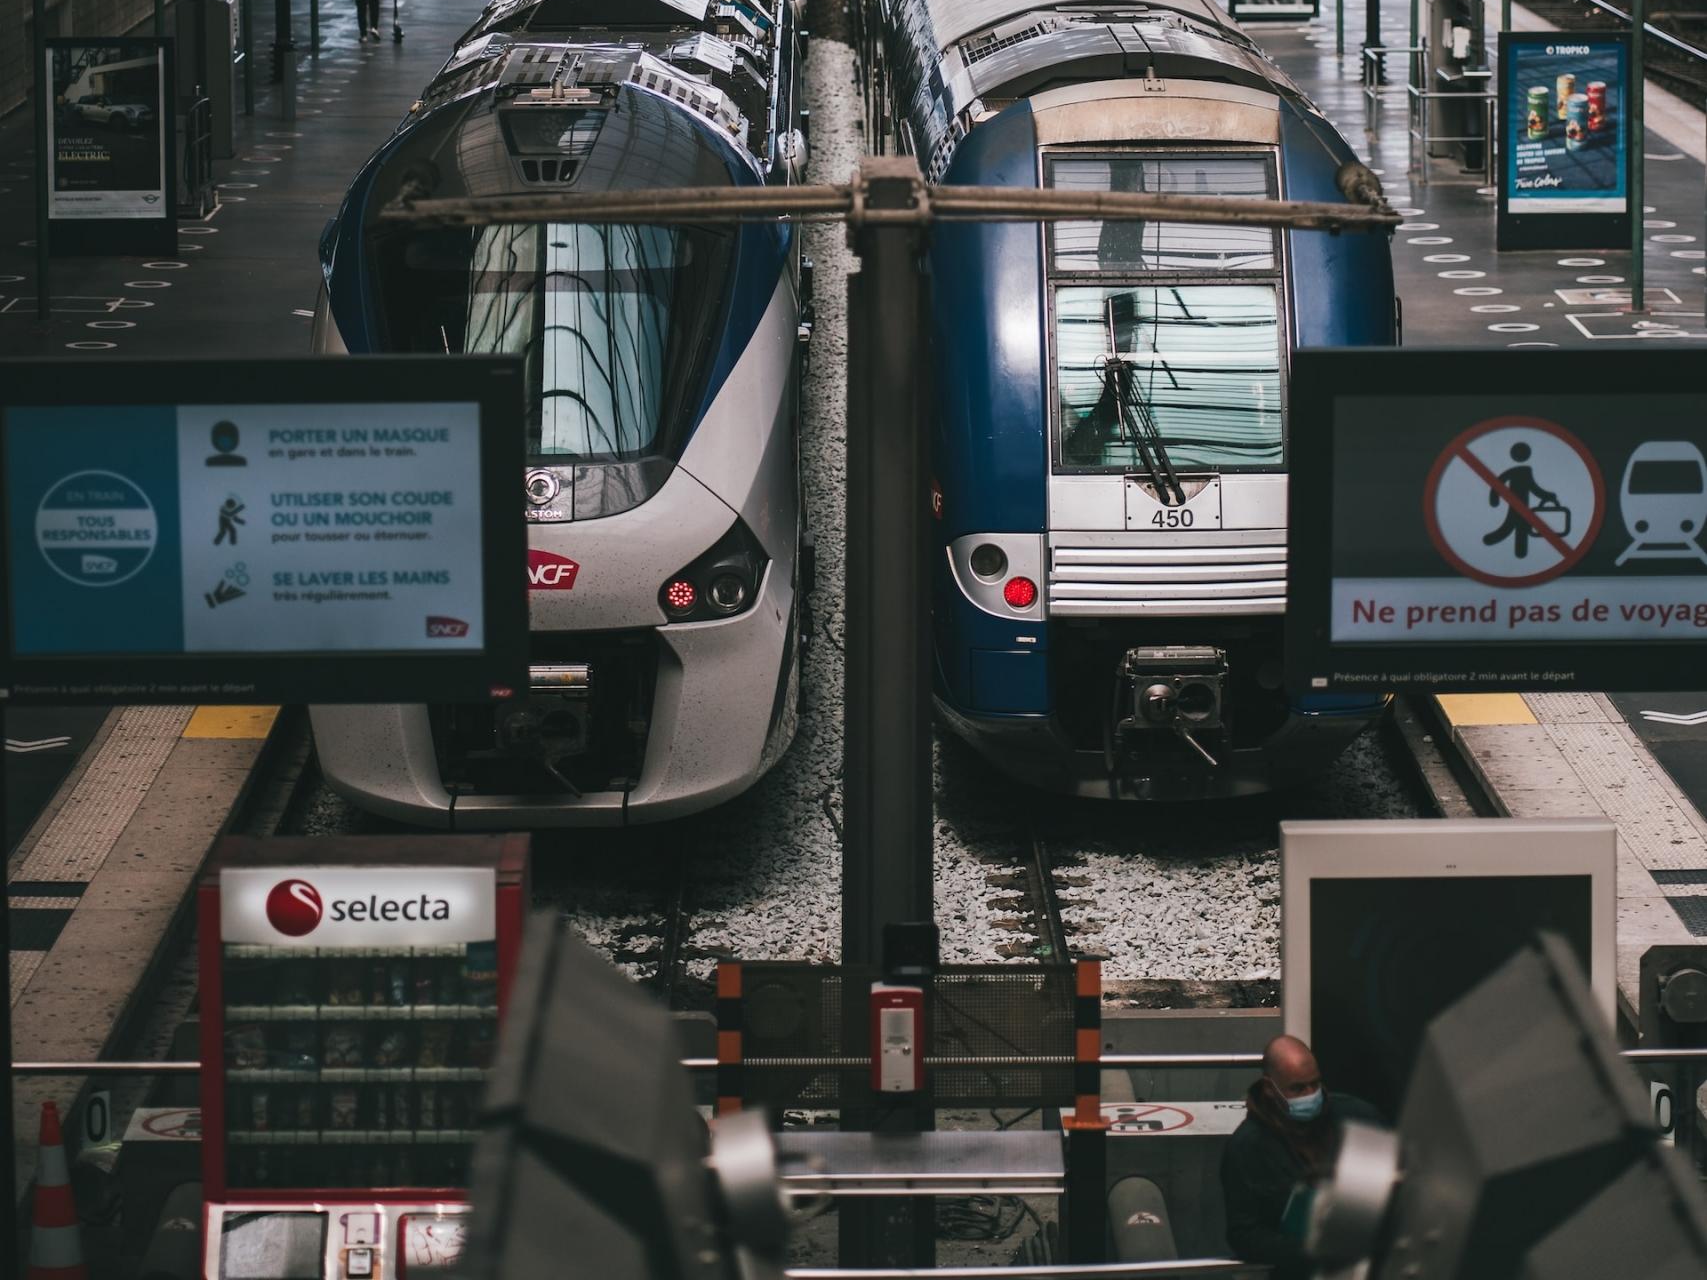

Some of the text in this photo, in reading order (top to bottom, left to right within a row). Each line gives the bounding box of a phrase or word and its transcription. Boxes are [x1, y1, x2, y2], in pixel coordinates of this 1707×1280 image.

[1555, 46, 1590, 55] TROPICO
[269, 428, 449, 443] PORTER UN MASQUE
[268, 446, 417, 460] en gare et dans le train.
[271, 491, 453, 507] UTILISER SON COUDE
[77, 516, 115, 527] TOUS
[271, 511, 433, 526] OU UN MOUCHOIR
[1152, 509, 1193, 528] 450
[42, 529, 151, 541] RESPONSABLES
[271, 530, 432, 544] pour tousser ou éternuer.
[273, 570, 450, 586] SE LAVER LES MAINS
[273, 590, 392, 603] très régulièrement.
[1353, 600, 1395, 623] Ne
[1407, 598, 1497, 629] prend
[1509, 604, 1561, 629] pas
[1572, 598, 1609, 622] de
[430, 624, 466, 635] SNCF
[1334, 671, 1575, 683] Présence à quai obligatoire 2 min avant le départ
[330, 894, 449, 921] selecta
